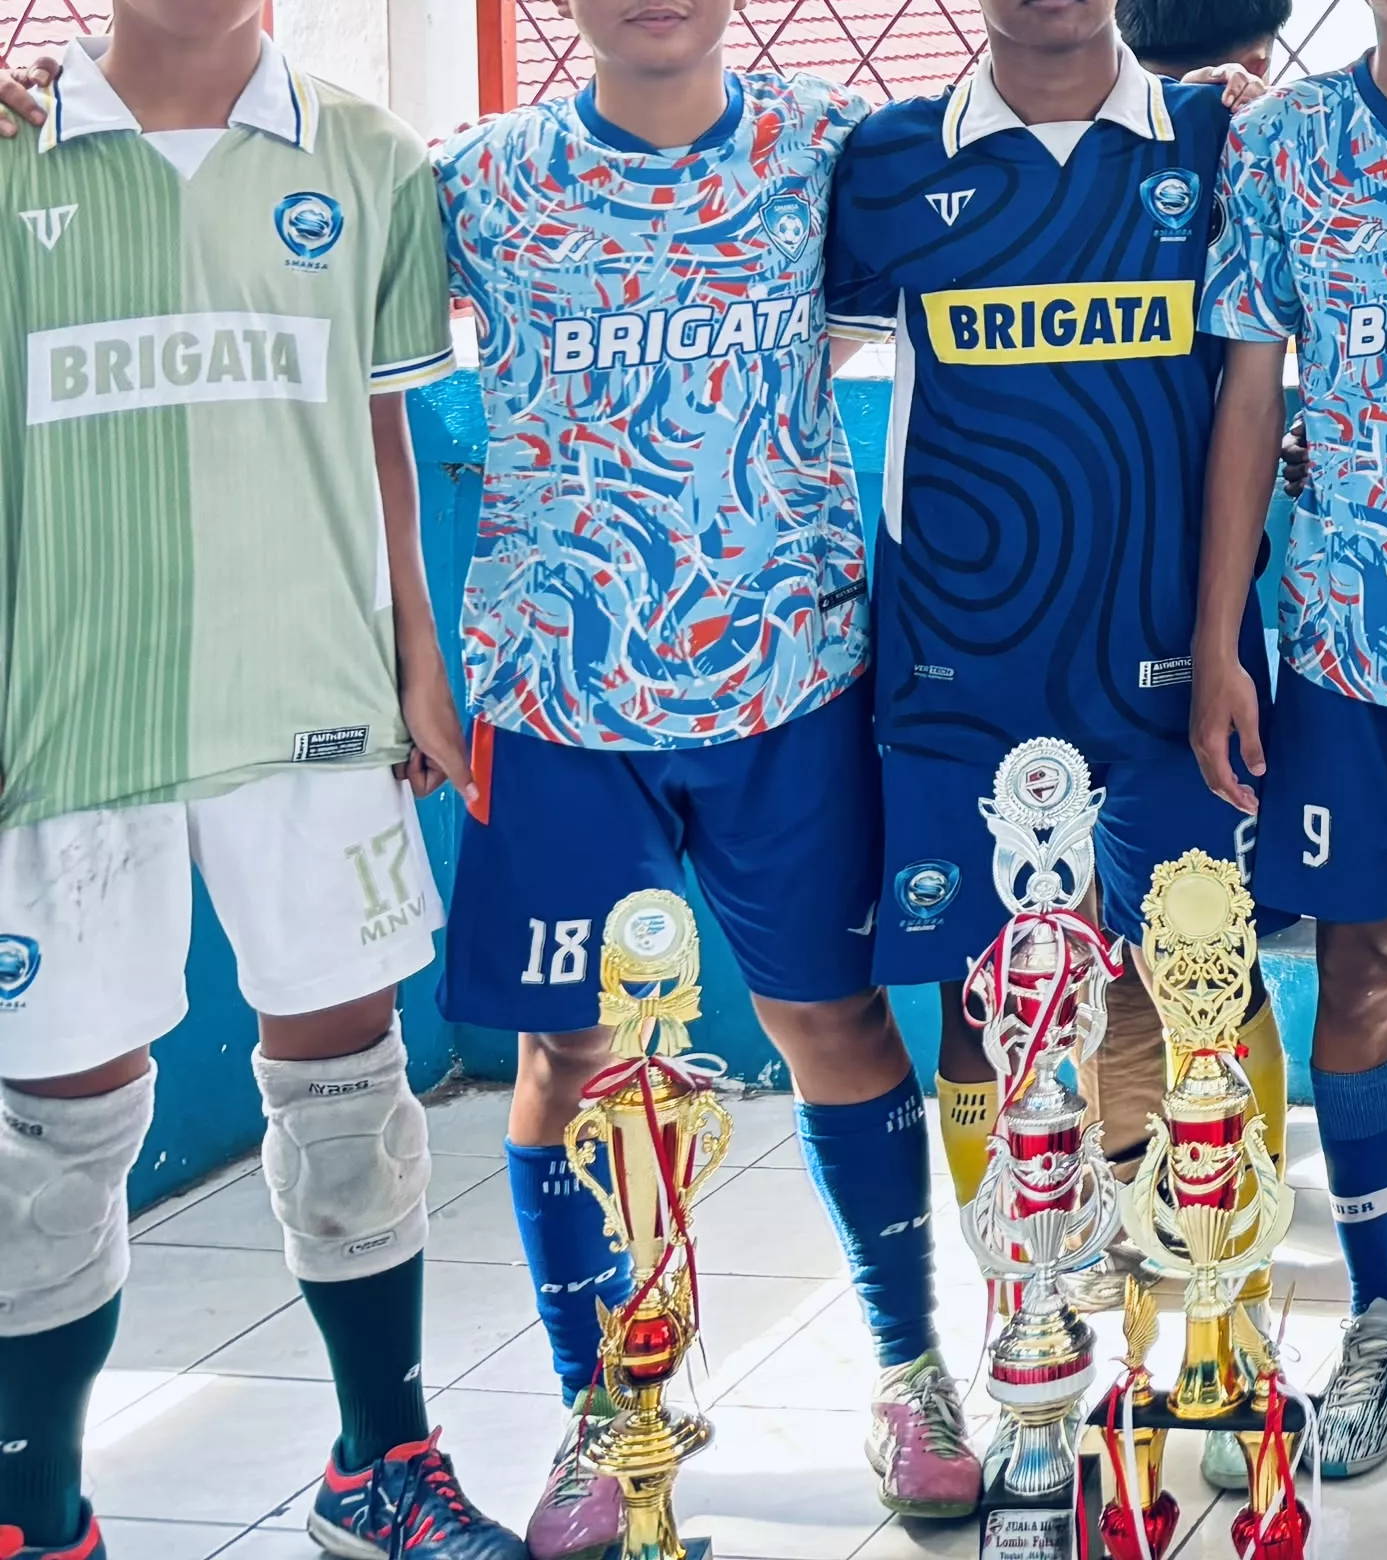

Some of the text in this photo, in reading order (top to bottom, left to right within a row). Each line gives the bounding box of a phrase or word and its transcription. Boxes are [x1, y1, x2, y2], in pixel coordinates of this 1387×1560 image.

[284, 259, 328, 270] SMANSA
[553, 292, 813, 374] BRIGATA
[949, 296, 1172, 350] BRIGATA
[50, 332, 302, 402] BRIGATA
[311, 729, 365, 743] AUTHENTIC
[1303, 804, 1331, 868] 9
[343, 824, 411, 920] 17
[361, 890, 425, 946] MNV
[521, 917, 593, 984] 18
[880, 1212, 931, 1237] av
